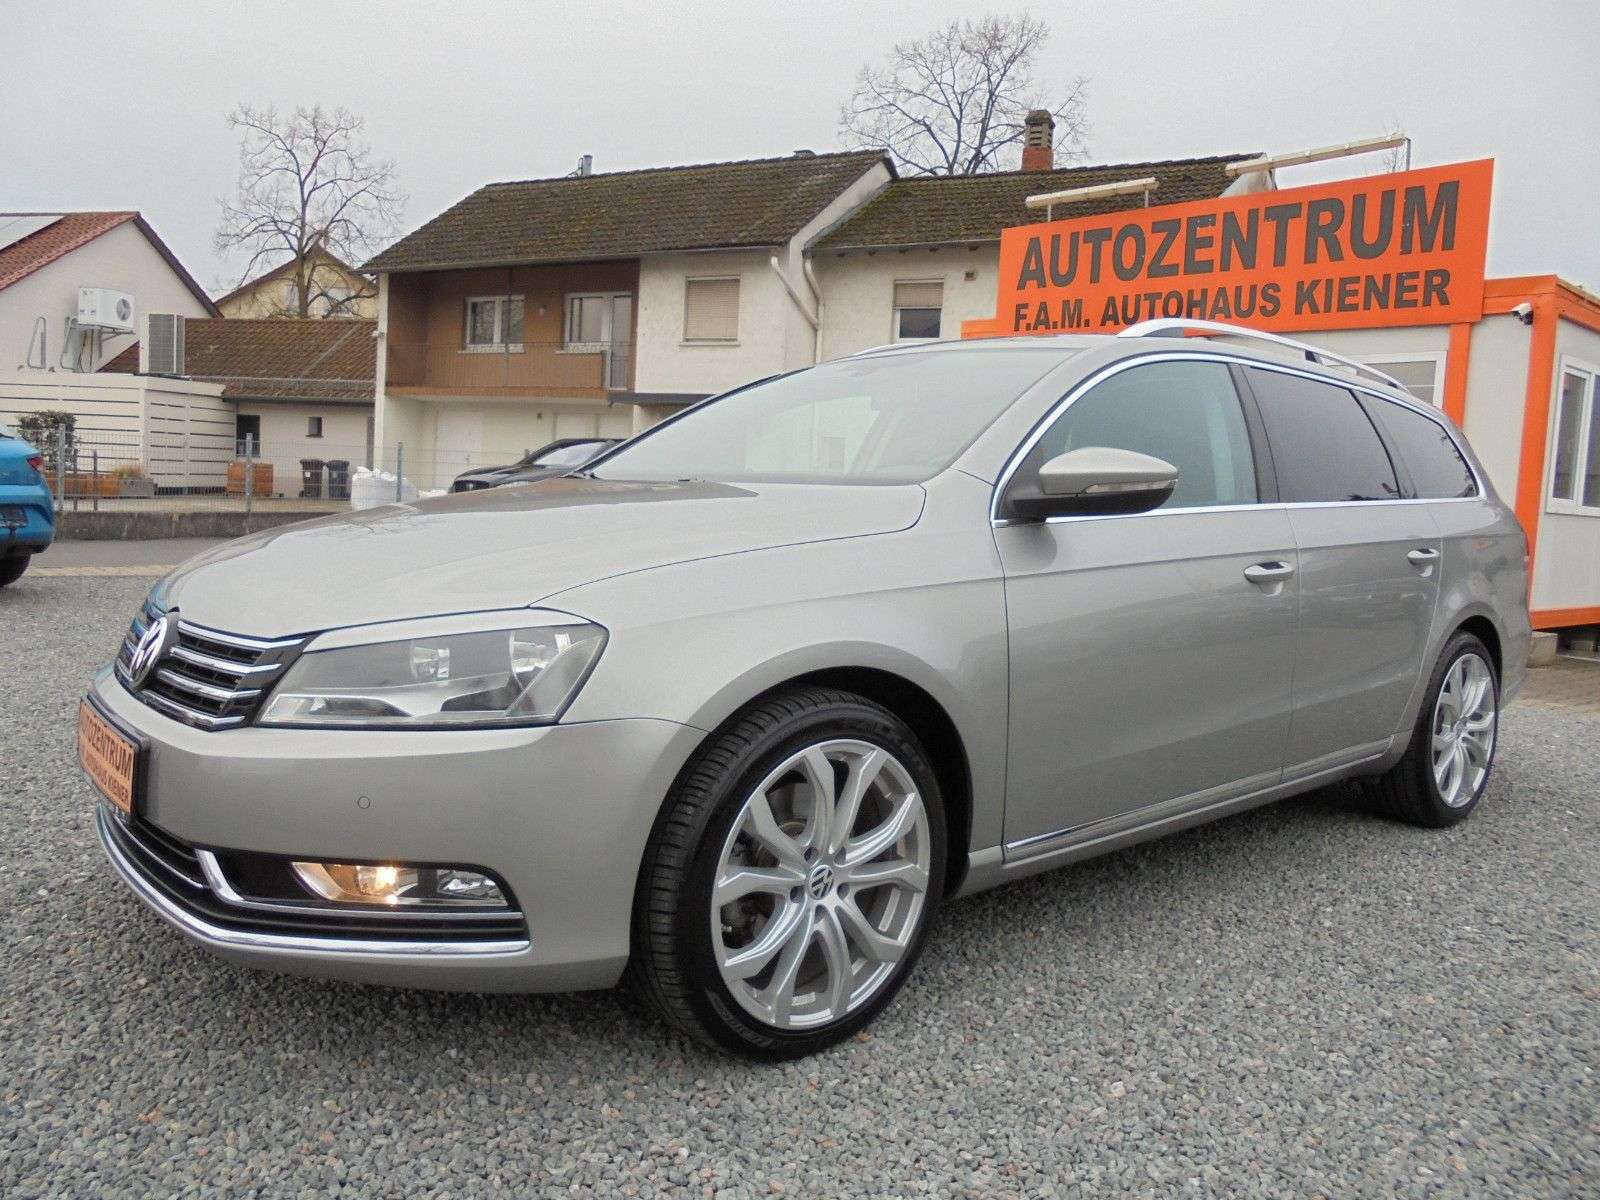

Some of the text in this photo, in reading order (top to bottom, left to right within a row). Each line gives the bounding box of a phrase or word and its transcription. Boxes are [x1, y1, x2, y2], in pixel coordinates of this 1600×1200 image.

[1017, 180, 1460, 291] AUTOZENTRUM
[1013, 269, 1450, 332] F.A.M. AUTOHAUS KIENER
